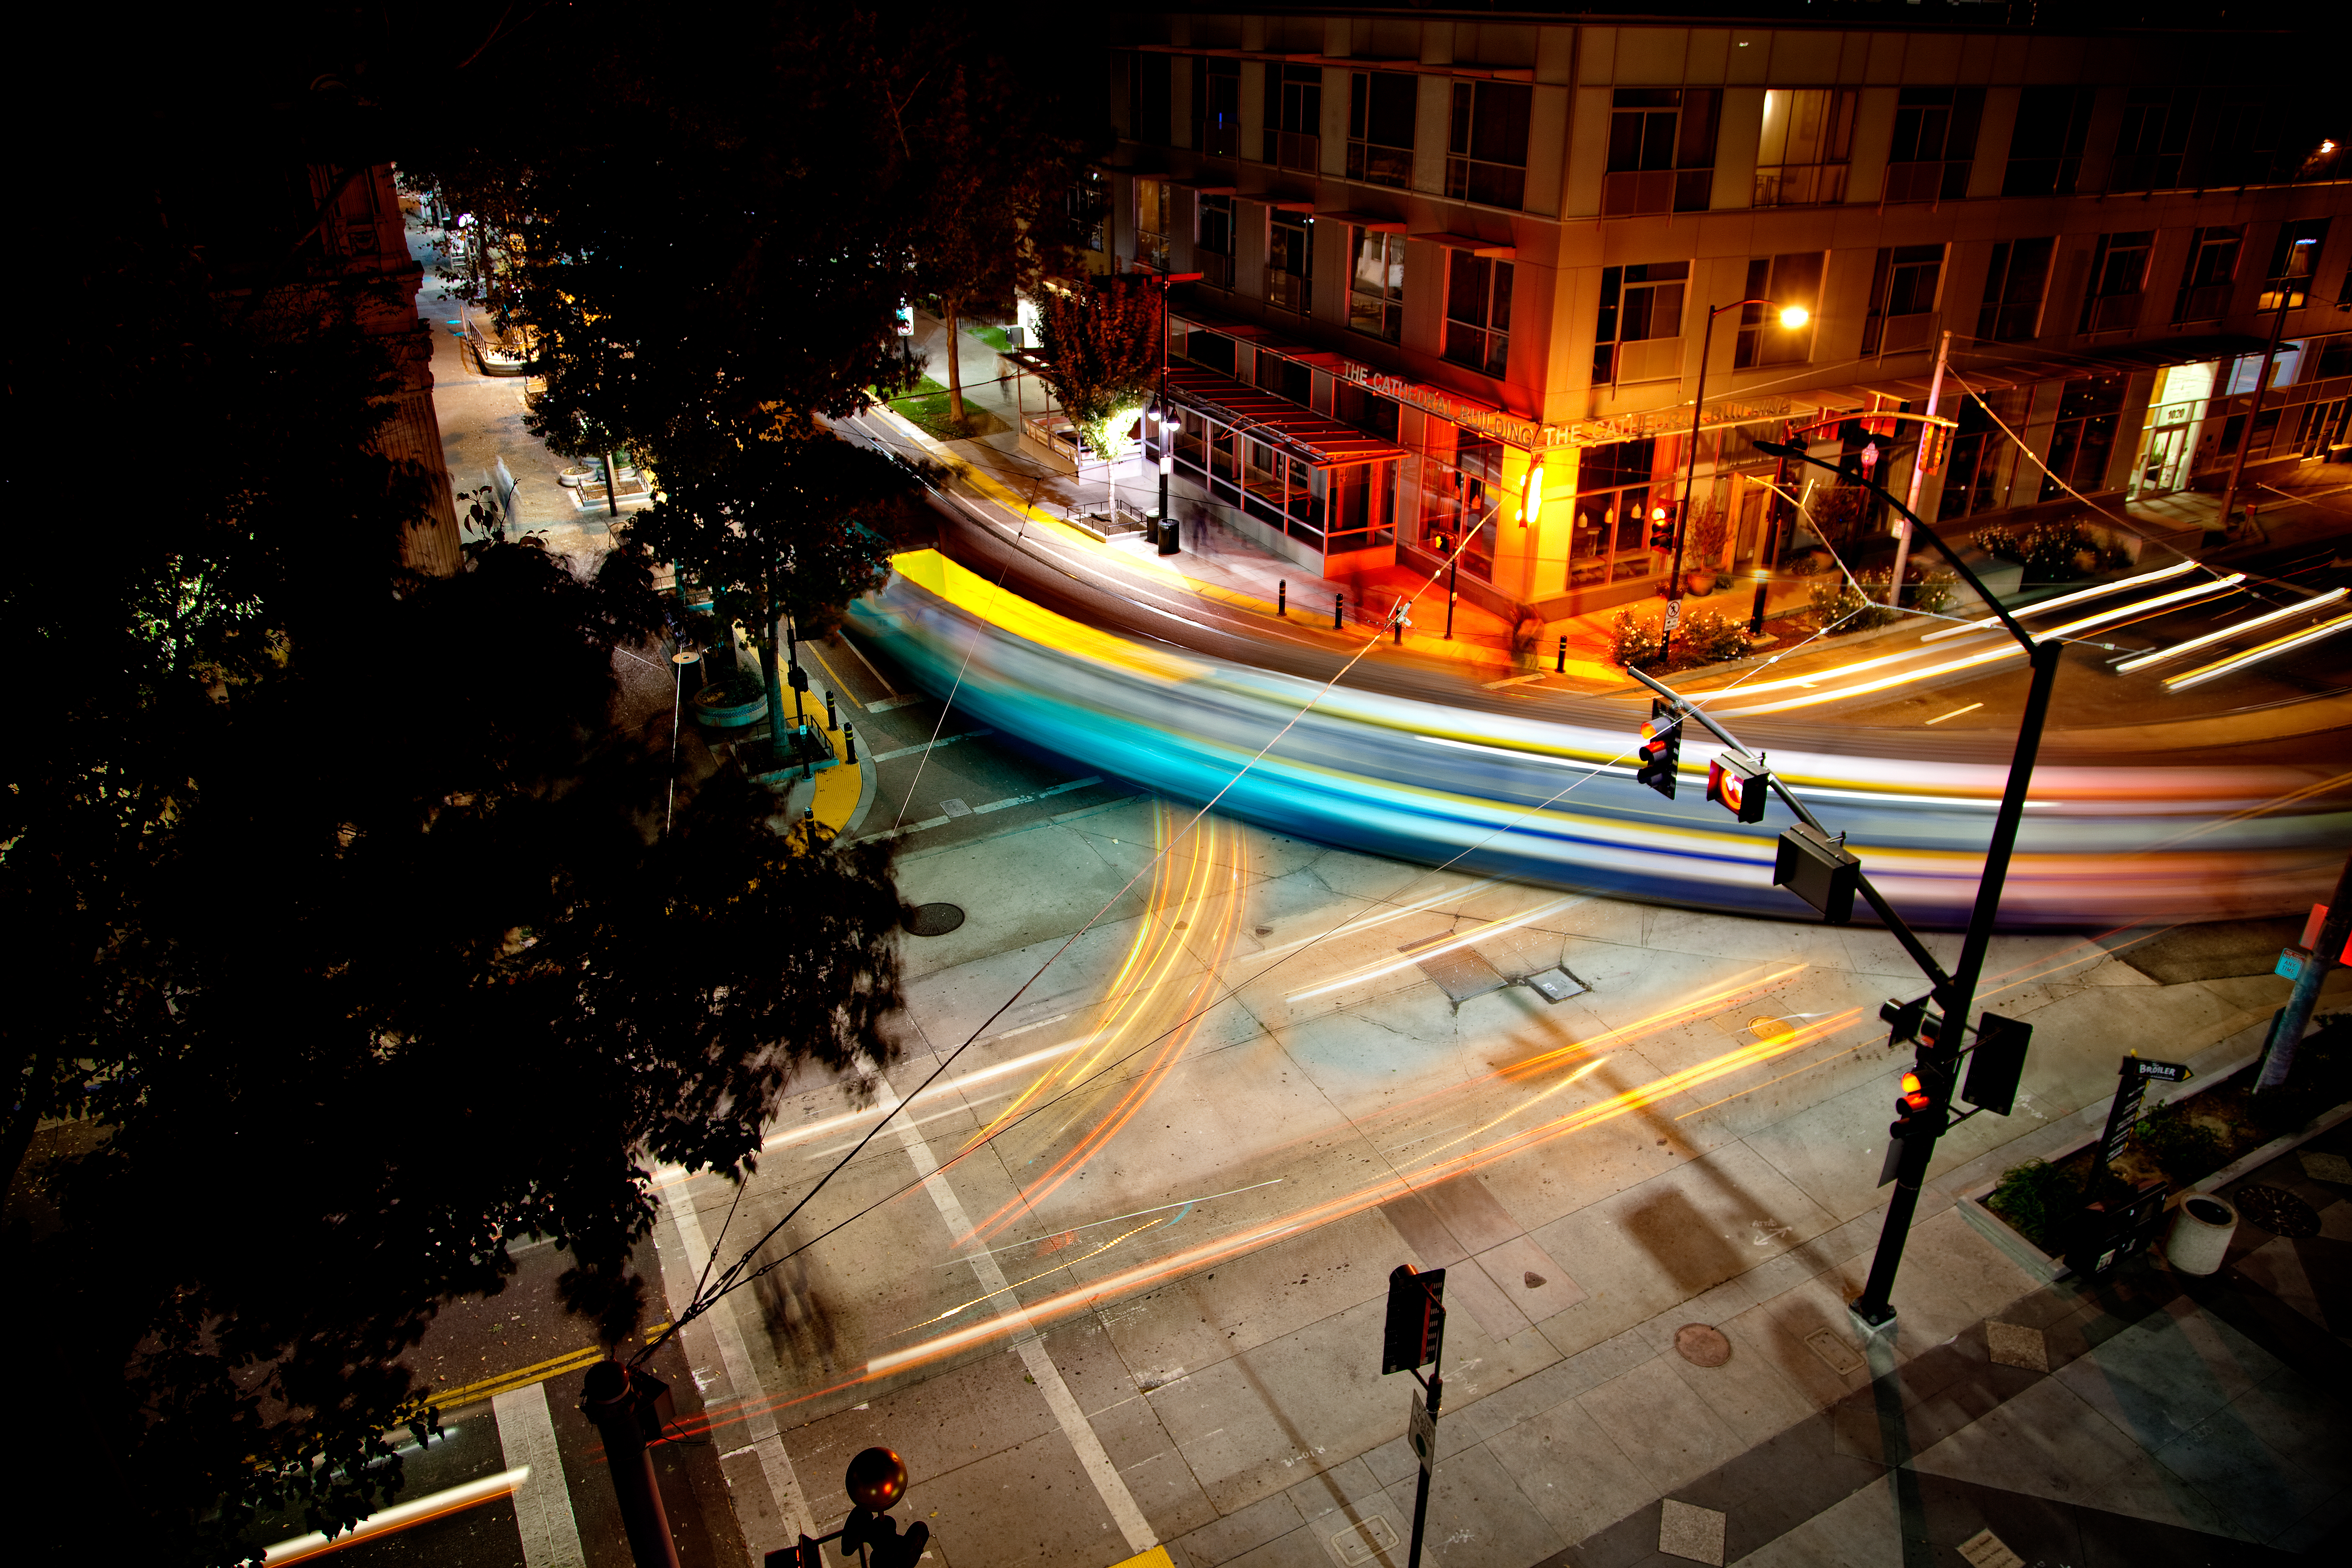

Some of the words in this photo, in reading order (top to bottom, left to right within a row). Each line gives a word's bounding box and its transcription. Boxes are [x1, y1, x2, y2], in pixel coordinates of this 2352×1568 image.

[1344, 361, 1368, 385] THE
[1373, 372, 1455, 419] CATHEDRAL
[1460, 404, 1534, 447] BUILDING
[2168, 408, 2185, 420] 1020
[1544, 424, 1583, 446] THE
[1593, 410, 1697, 439] CATHEDRA
[2139, 1063, 2176, 1077] BROILER
